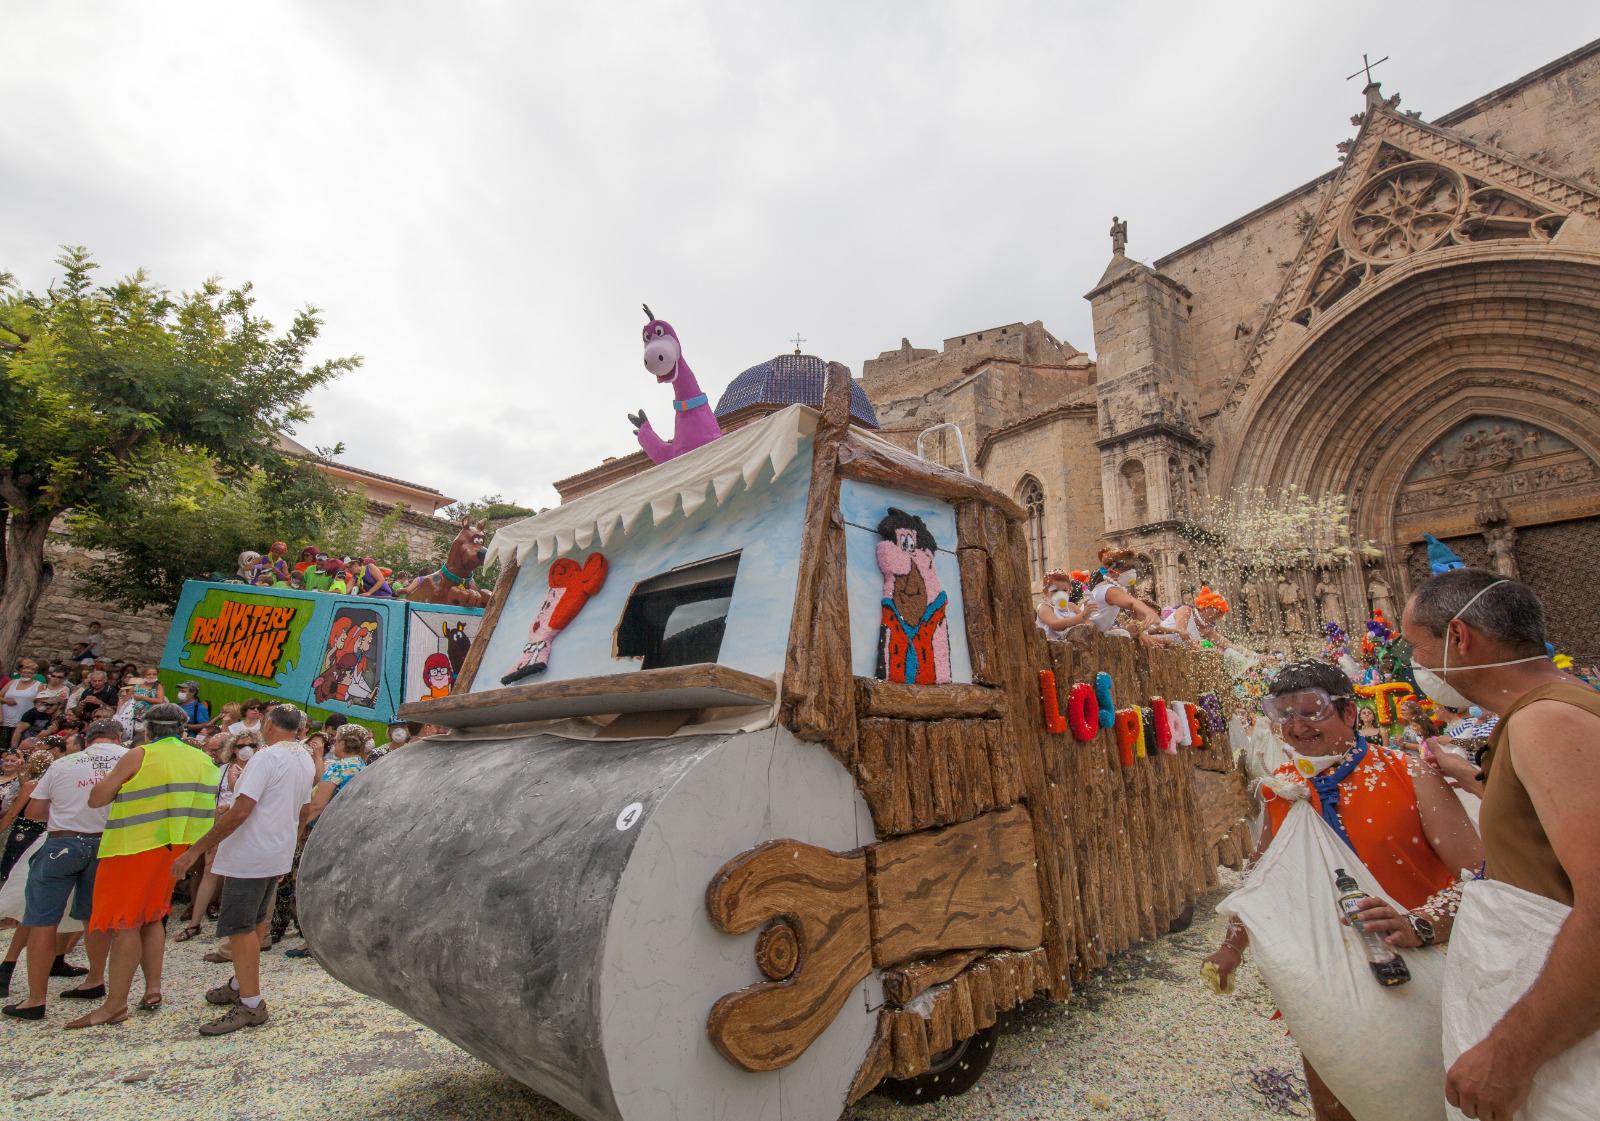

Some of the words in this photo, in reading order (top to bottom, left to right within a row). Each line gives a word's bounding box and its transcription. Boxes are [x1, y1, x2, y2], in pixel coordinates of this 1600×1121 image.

[190, 616, 219, 645] THE
[211, 600, 297, 643] MYSTERY
[204, 631, 290, 679] MACHINE
[1040, 669, 1115, 742] LOS
[92, 762, 112, 770] DEL
[622, 809, 637, 827] 4
